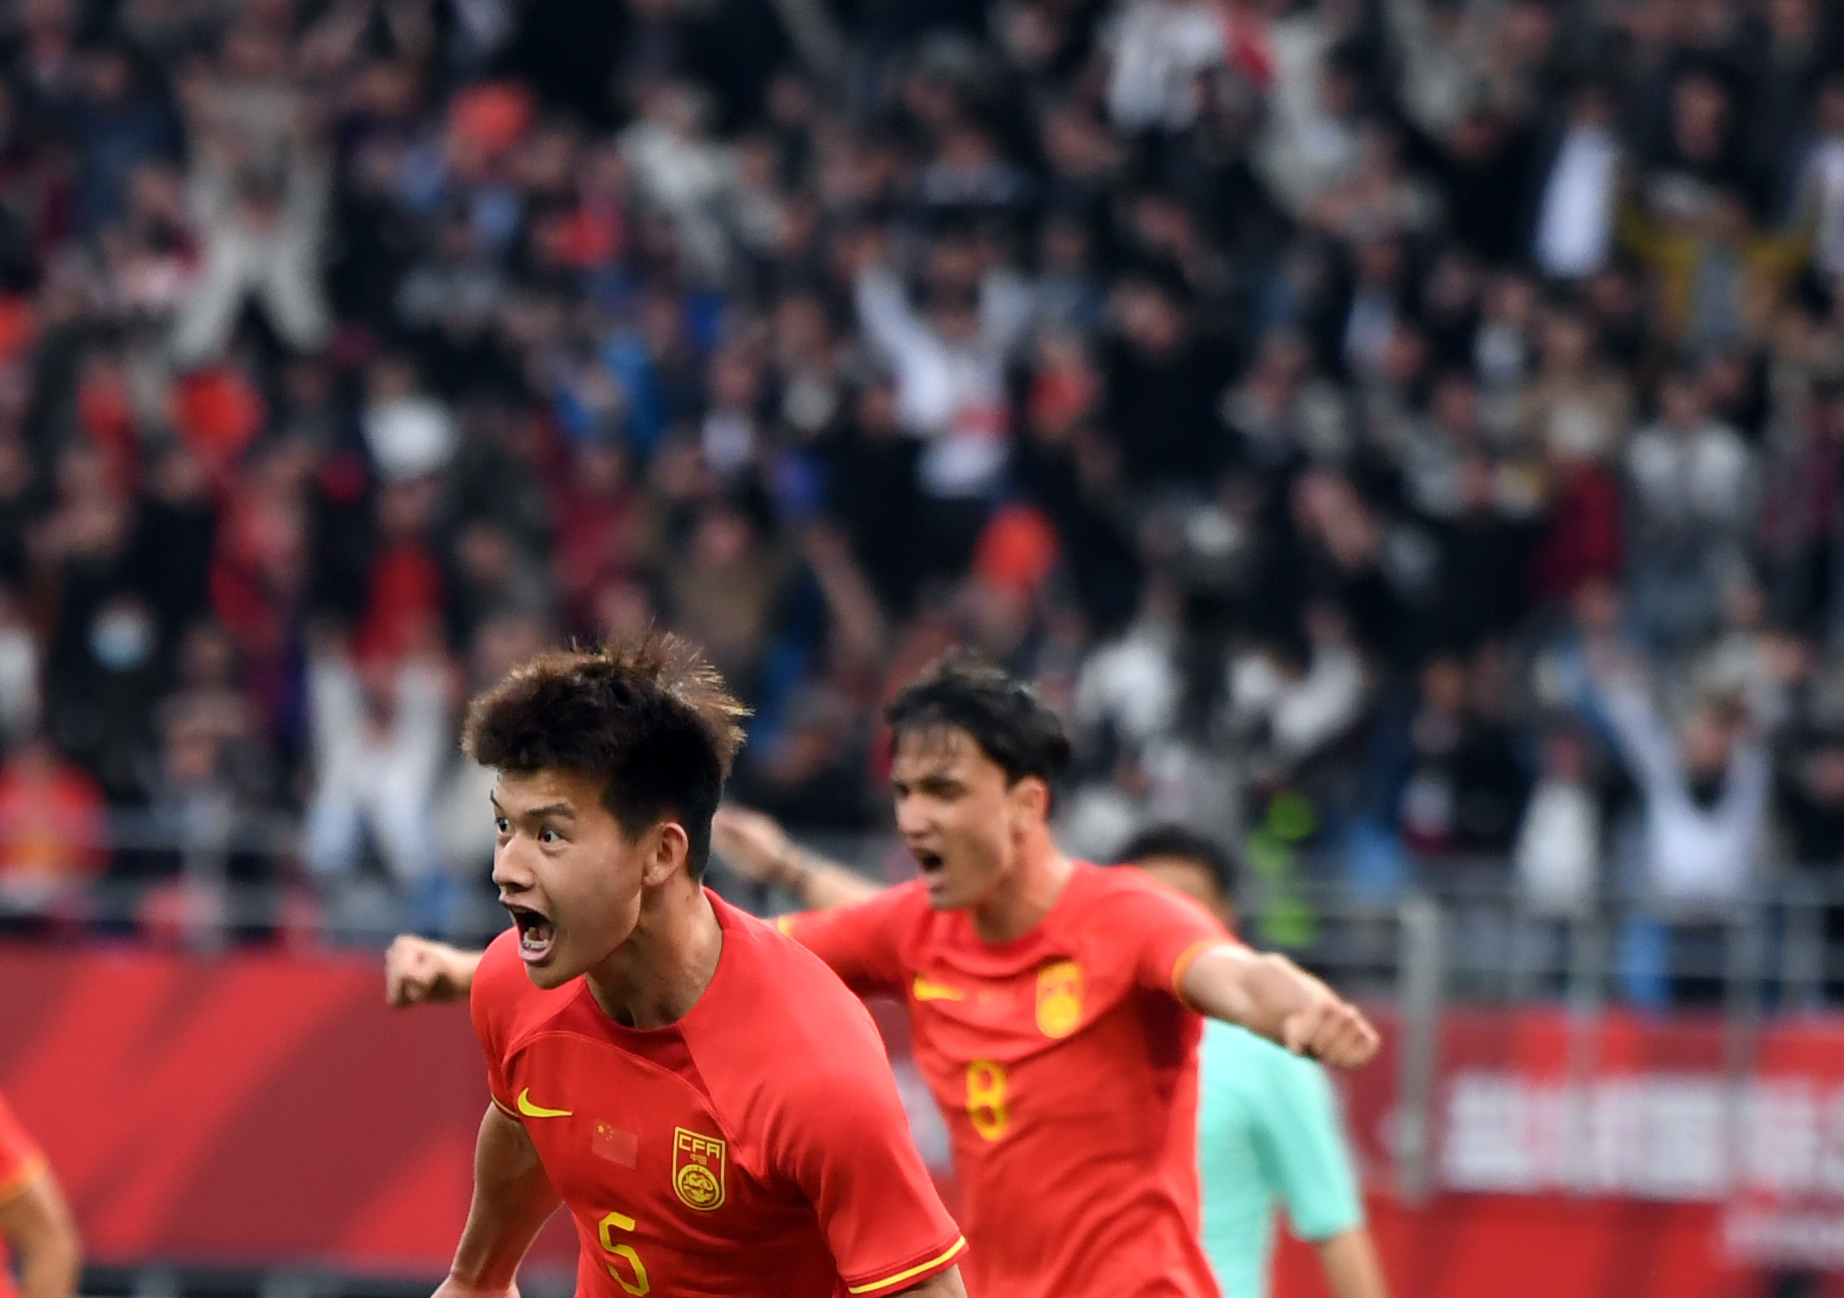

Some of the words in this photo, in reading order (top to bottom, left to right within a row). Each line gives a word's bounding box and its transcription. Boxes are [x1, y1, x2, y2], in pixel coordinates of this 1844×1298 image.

[965, 1059, 1007, 1142] 8
[678, 1134, 721, 1160] CFA
[598, 1211, 651, 1298] 5
